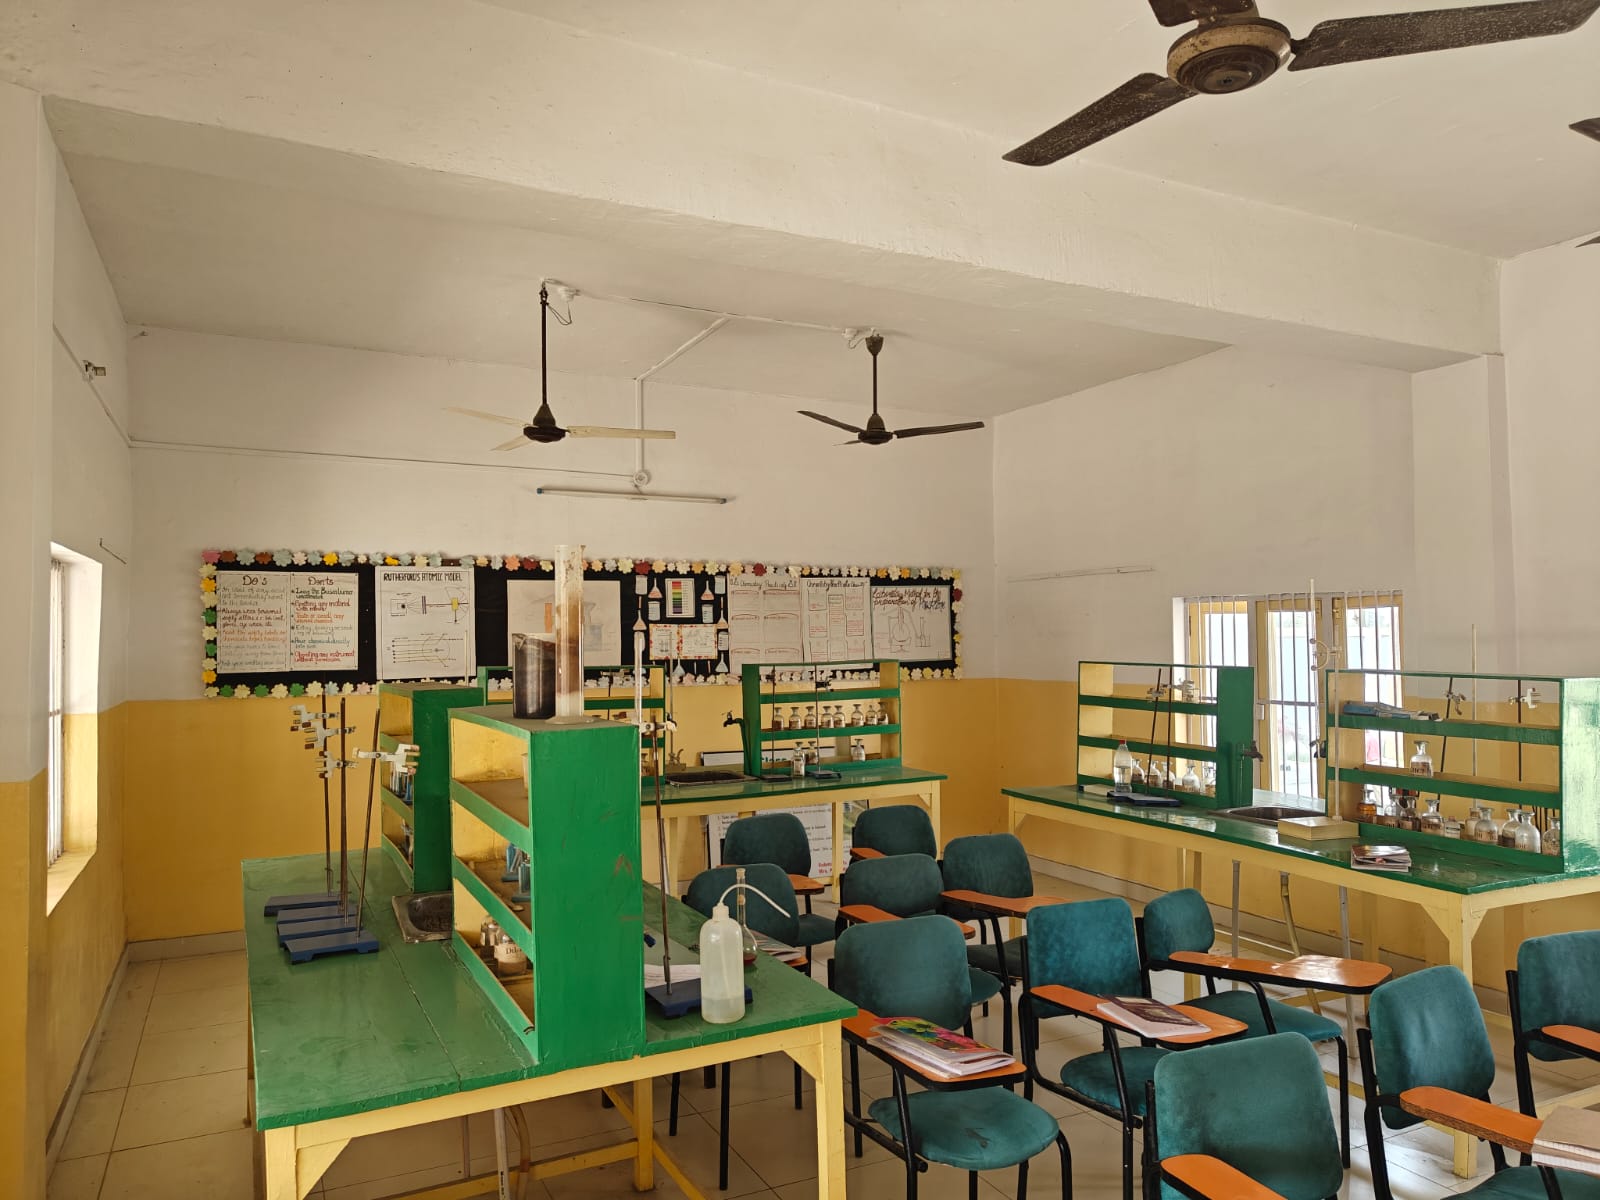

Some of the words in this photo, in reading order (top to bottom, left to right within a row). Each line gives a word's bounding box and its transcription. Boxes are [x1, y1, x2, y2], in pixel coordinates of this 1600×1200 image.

[383, 572, 421, 581] RUTHERFORD'S
[422, 572, 443, 581] ATOMIC
[444, 572, 463, 582] MODEL
